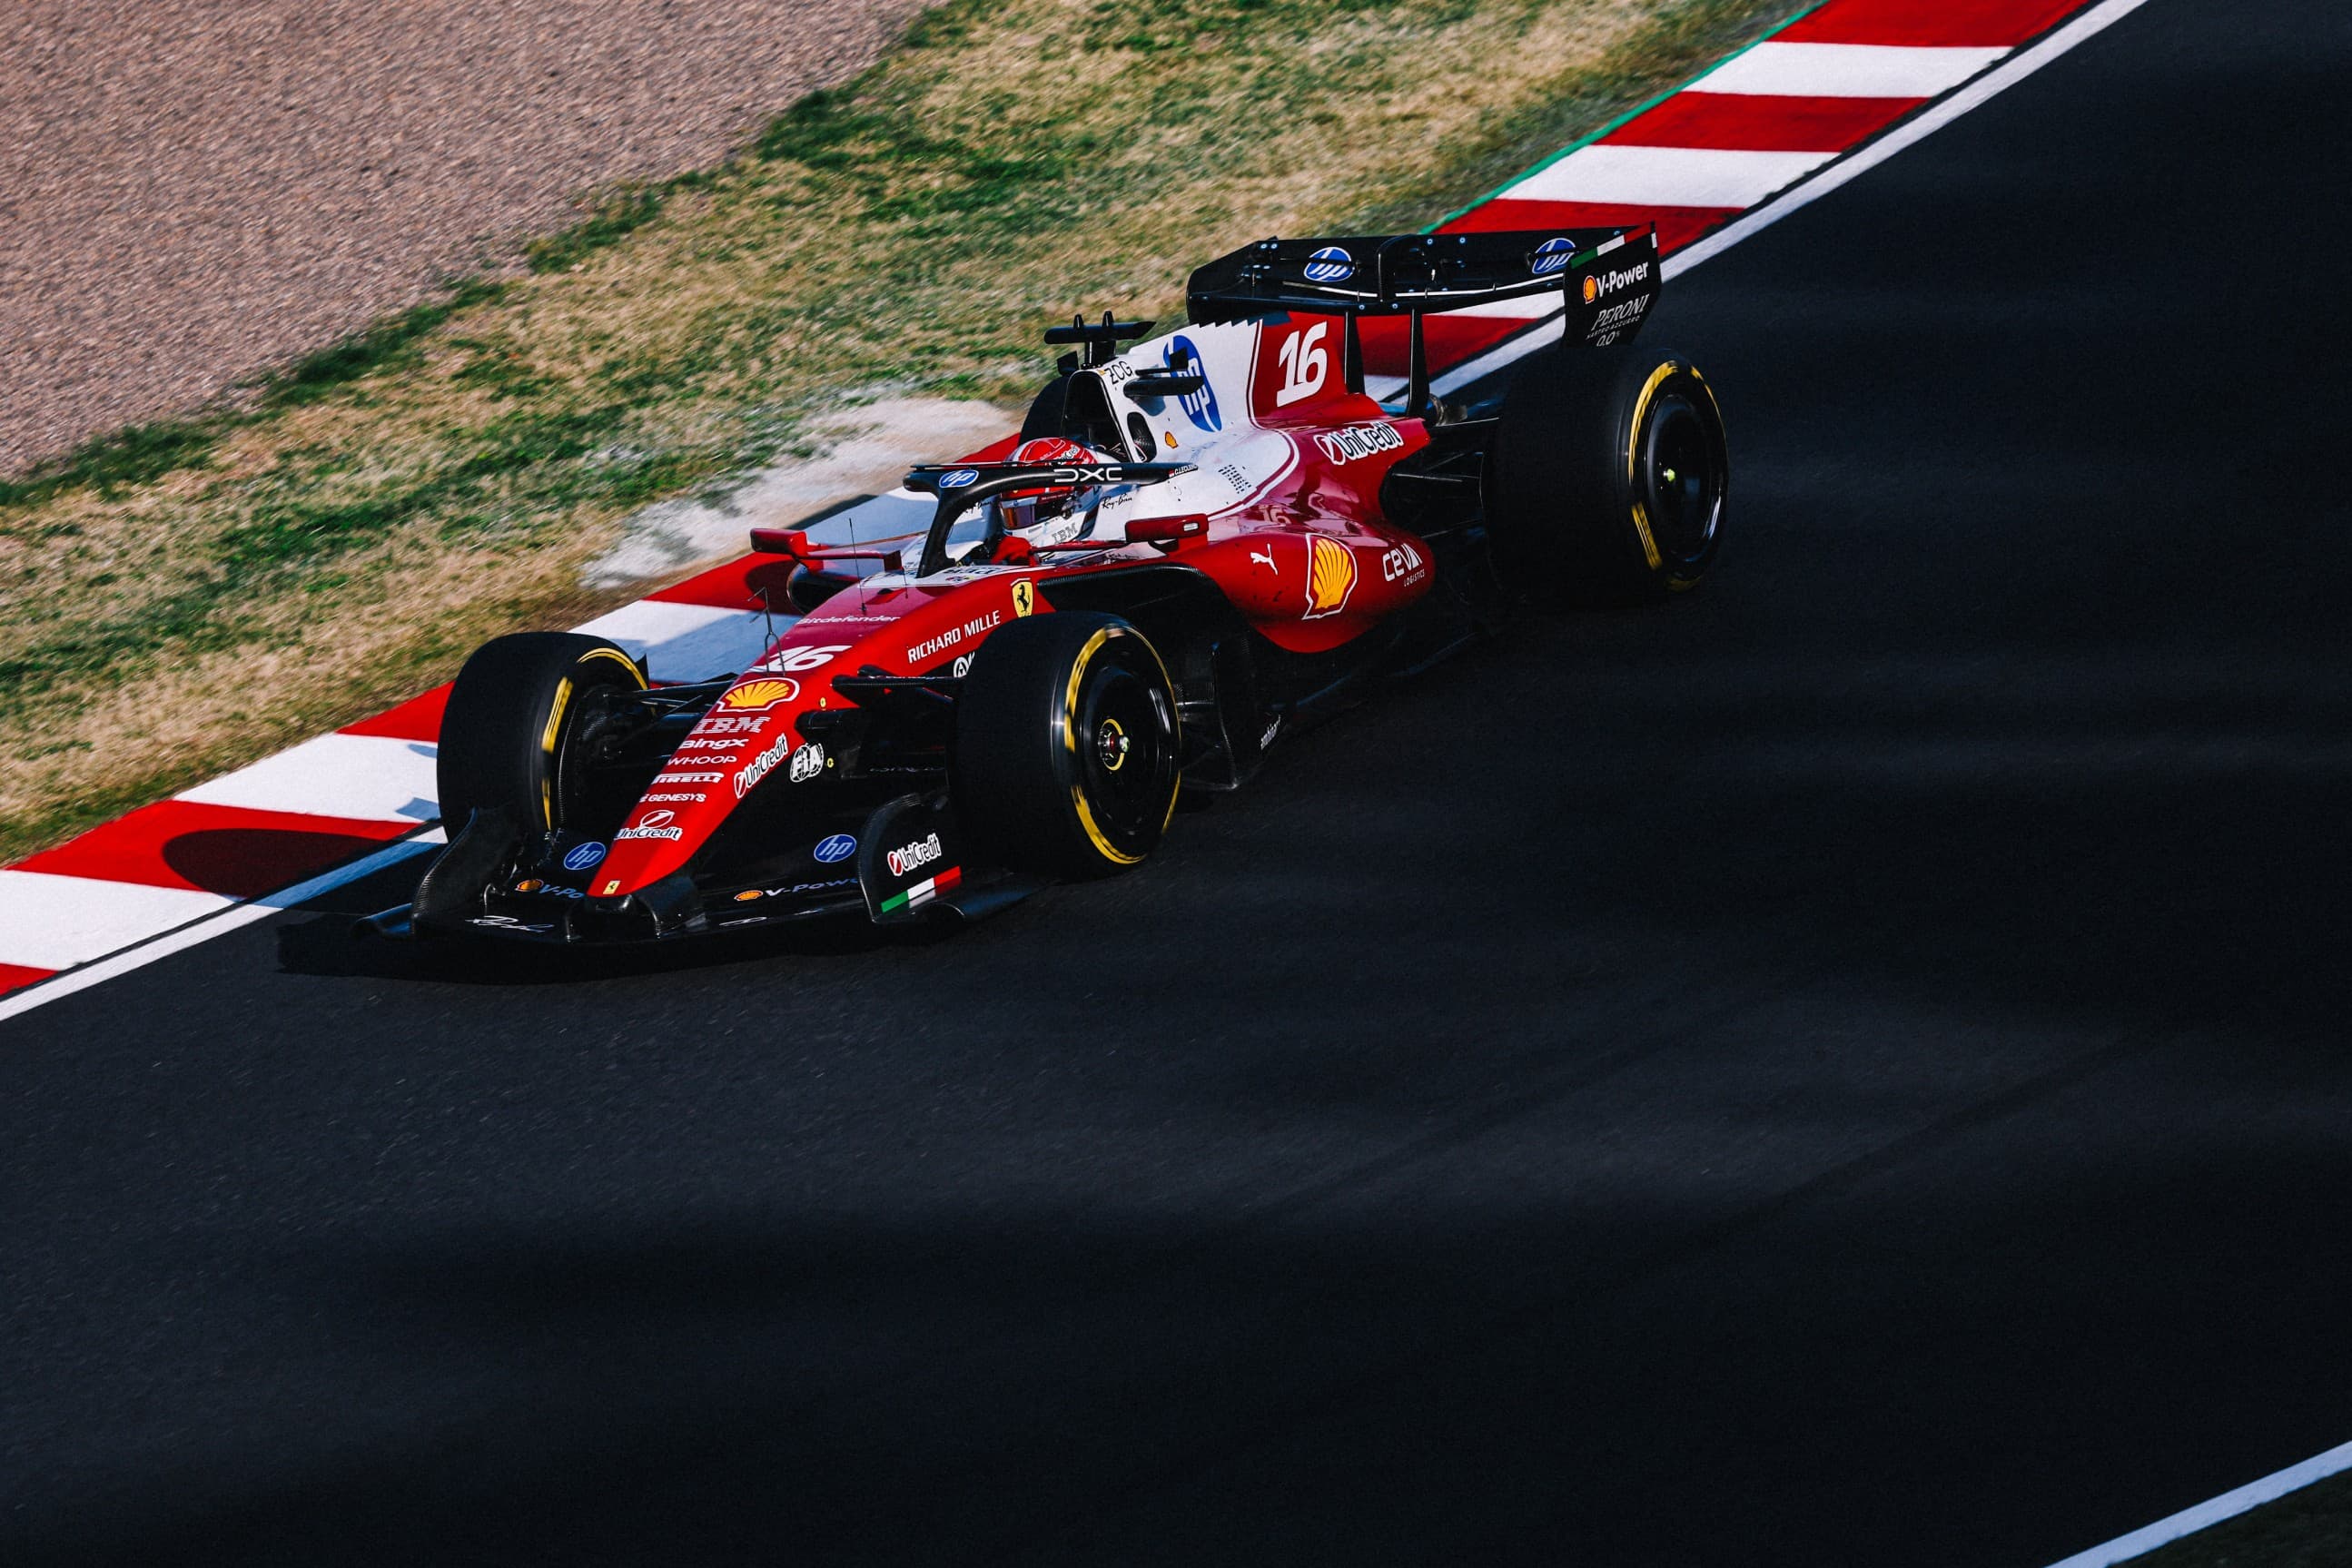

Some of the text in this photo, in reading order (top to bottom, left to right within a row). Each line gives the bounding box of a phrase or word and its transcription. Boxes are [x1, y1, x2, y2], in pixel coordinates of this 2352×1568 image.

[1596, 261, 1649, 298] V-Power
[1591, 293, 1650, 331] PERONI
[1104, 360, 1132, 385] ZCG
[1276, 321, 1328, 408] 16
[1330, 421, 1403, 460] UniCredit
[941, 469, 977, 488] hp
[1053, 467, 1122, 483] DXC
[1102, 493, 1132, 509] Ray-Ban
[1052, 522, 1078, 544] IBM
[1404, 568, 1426, 587] LOGISTICS
[796, 615, 901, 625] Bitdefender
[907, 609, 1001, 664] RICHARD MILLE
[748, 645, 853, 673] 16
[690, 716, 771, 735] IBM
[667, 755, 737, 765] WHOOP
[745, 733, 788, 788] UniCredit
[647, 793, 707, 803] GENESYS
[566, 842, 605, 870] hp
[816, 834, 855, 863] hp
[897, 832, 942, 872] UniCredit
[539, 883, 586, 900] V-Po
